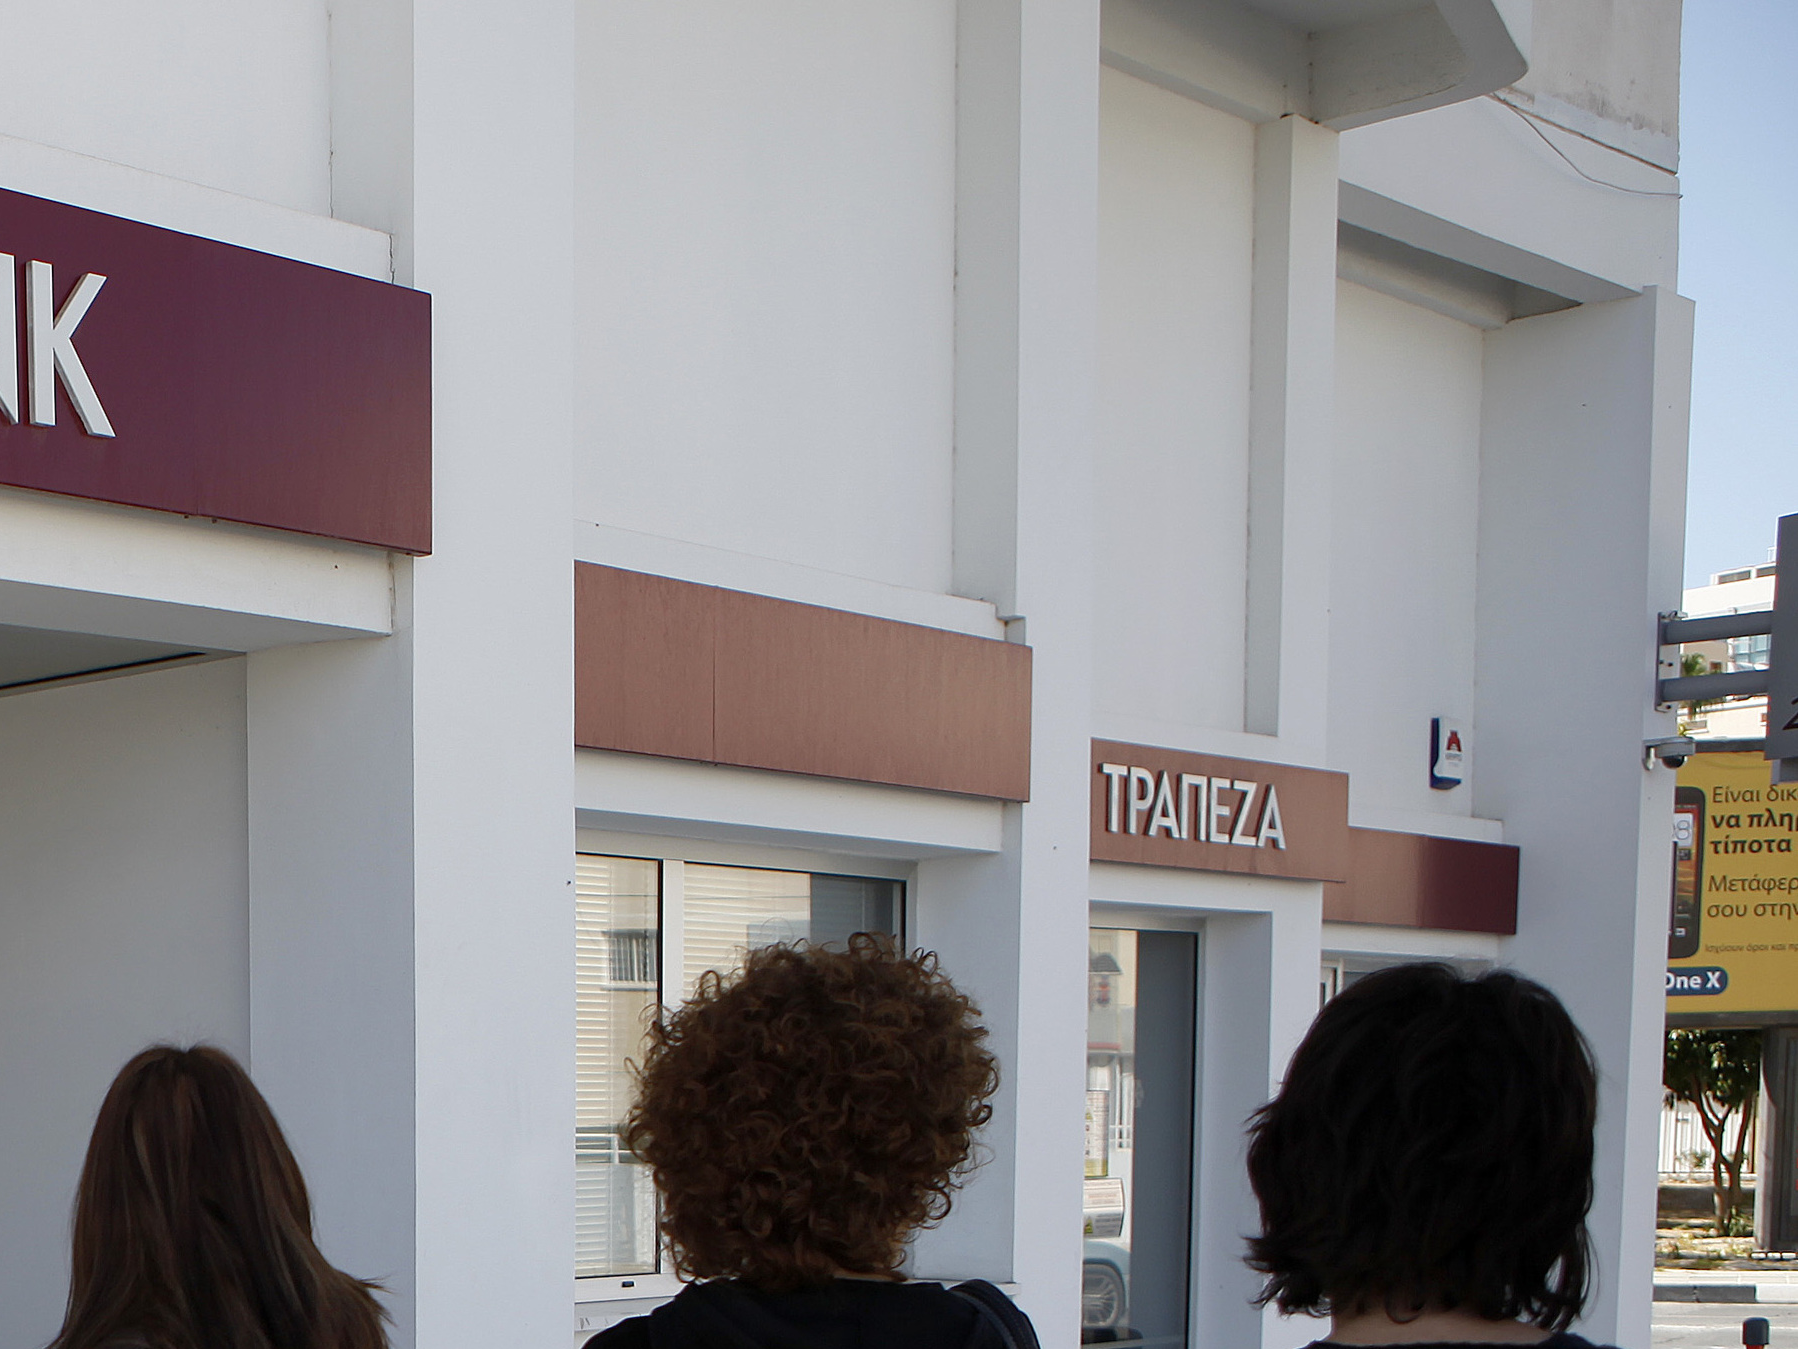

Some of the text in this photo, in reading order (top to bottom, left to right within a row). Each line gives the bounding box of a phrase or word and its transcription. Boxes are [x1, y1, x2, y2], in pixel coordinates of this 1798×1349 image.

[1712, 784, 1798, 804] Είναι δικ
[1099, 762, 1286, 850] ΤΡΑΠΕΖΑ
[1711, 813, 1741, 829] να
[1710, 835, 1792, 855] τίποτα
[1707, 904, 1747, 918] σου
[1706, 971, 1721, 988] X
